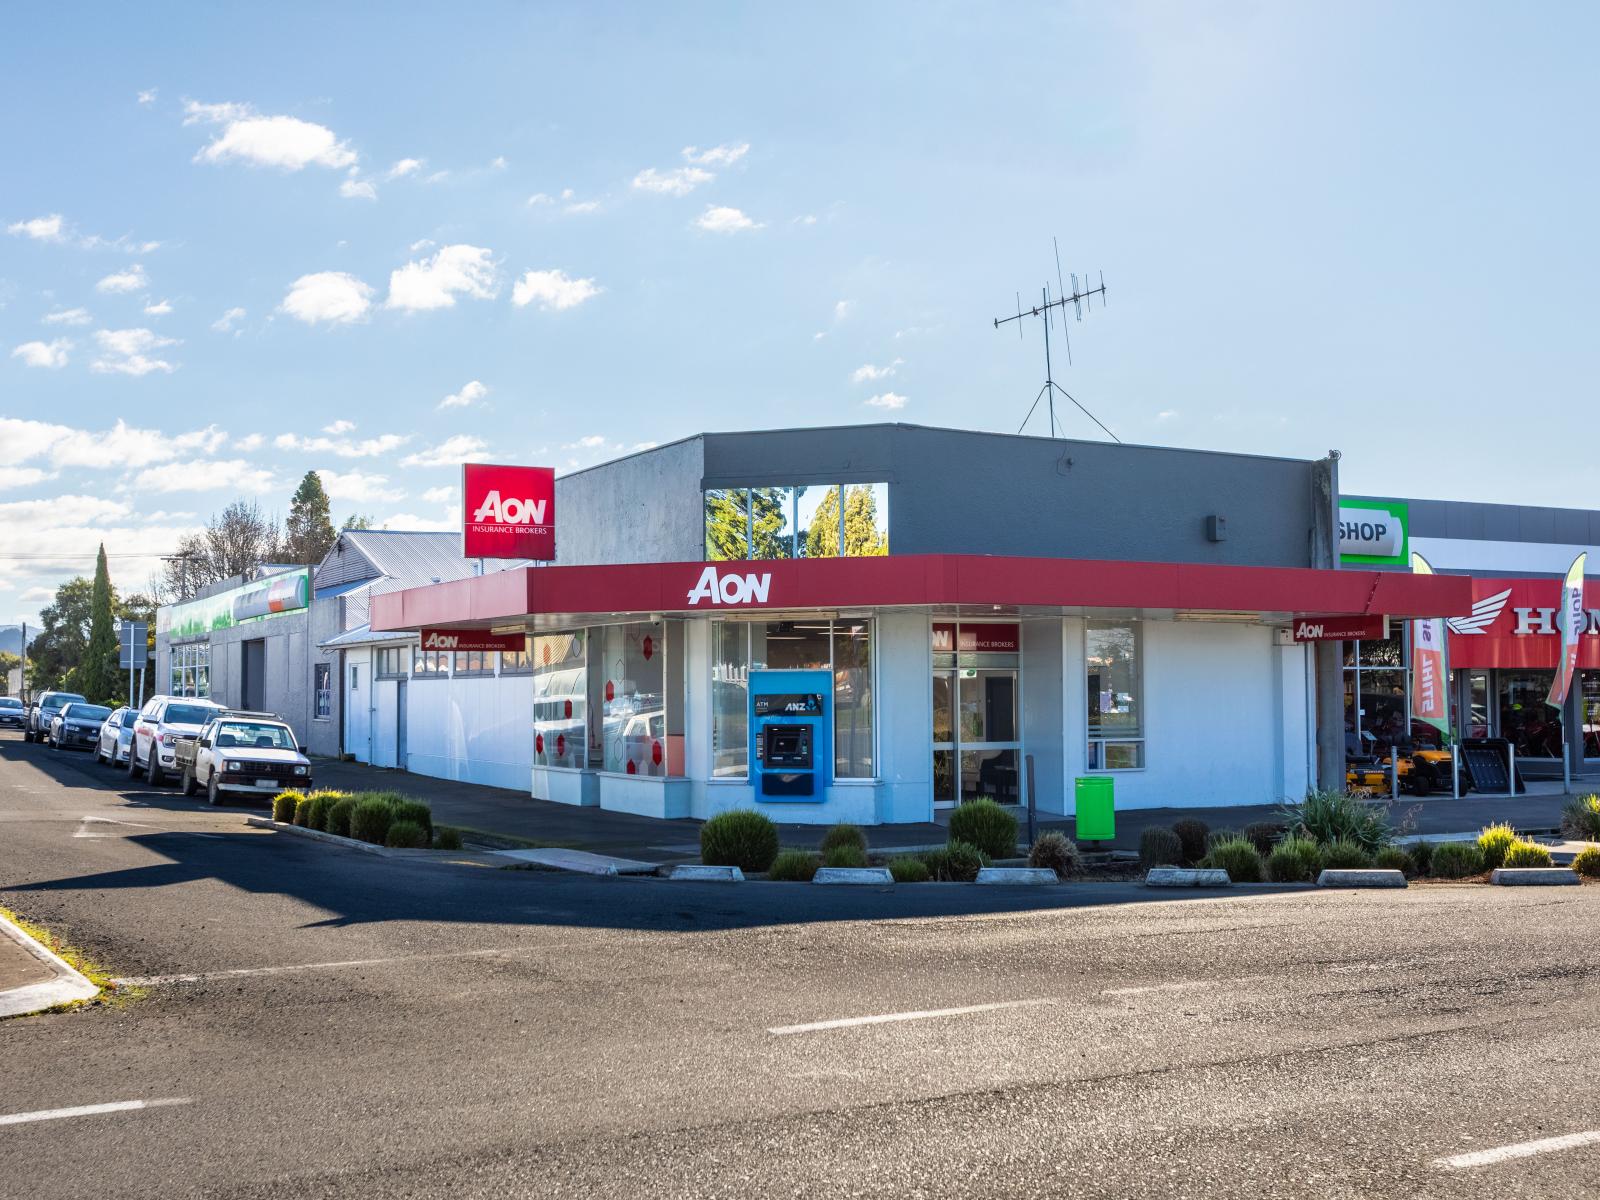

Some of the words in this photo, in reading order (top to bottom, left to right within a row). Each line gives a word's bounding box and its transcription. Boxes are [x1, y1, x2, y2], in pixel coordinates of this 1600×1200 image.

[472, 525, 514, 534] INSURANCE
[515, 527, 547, 535] BROKERS
[1339, 521, 1387, 541] SHOP
[785, 702, 806, 711] ANZ
